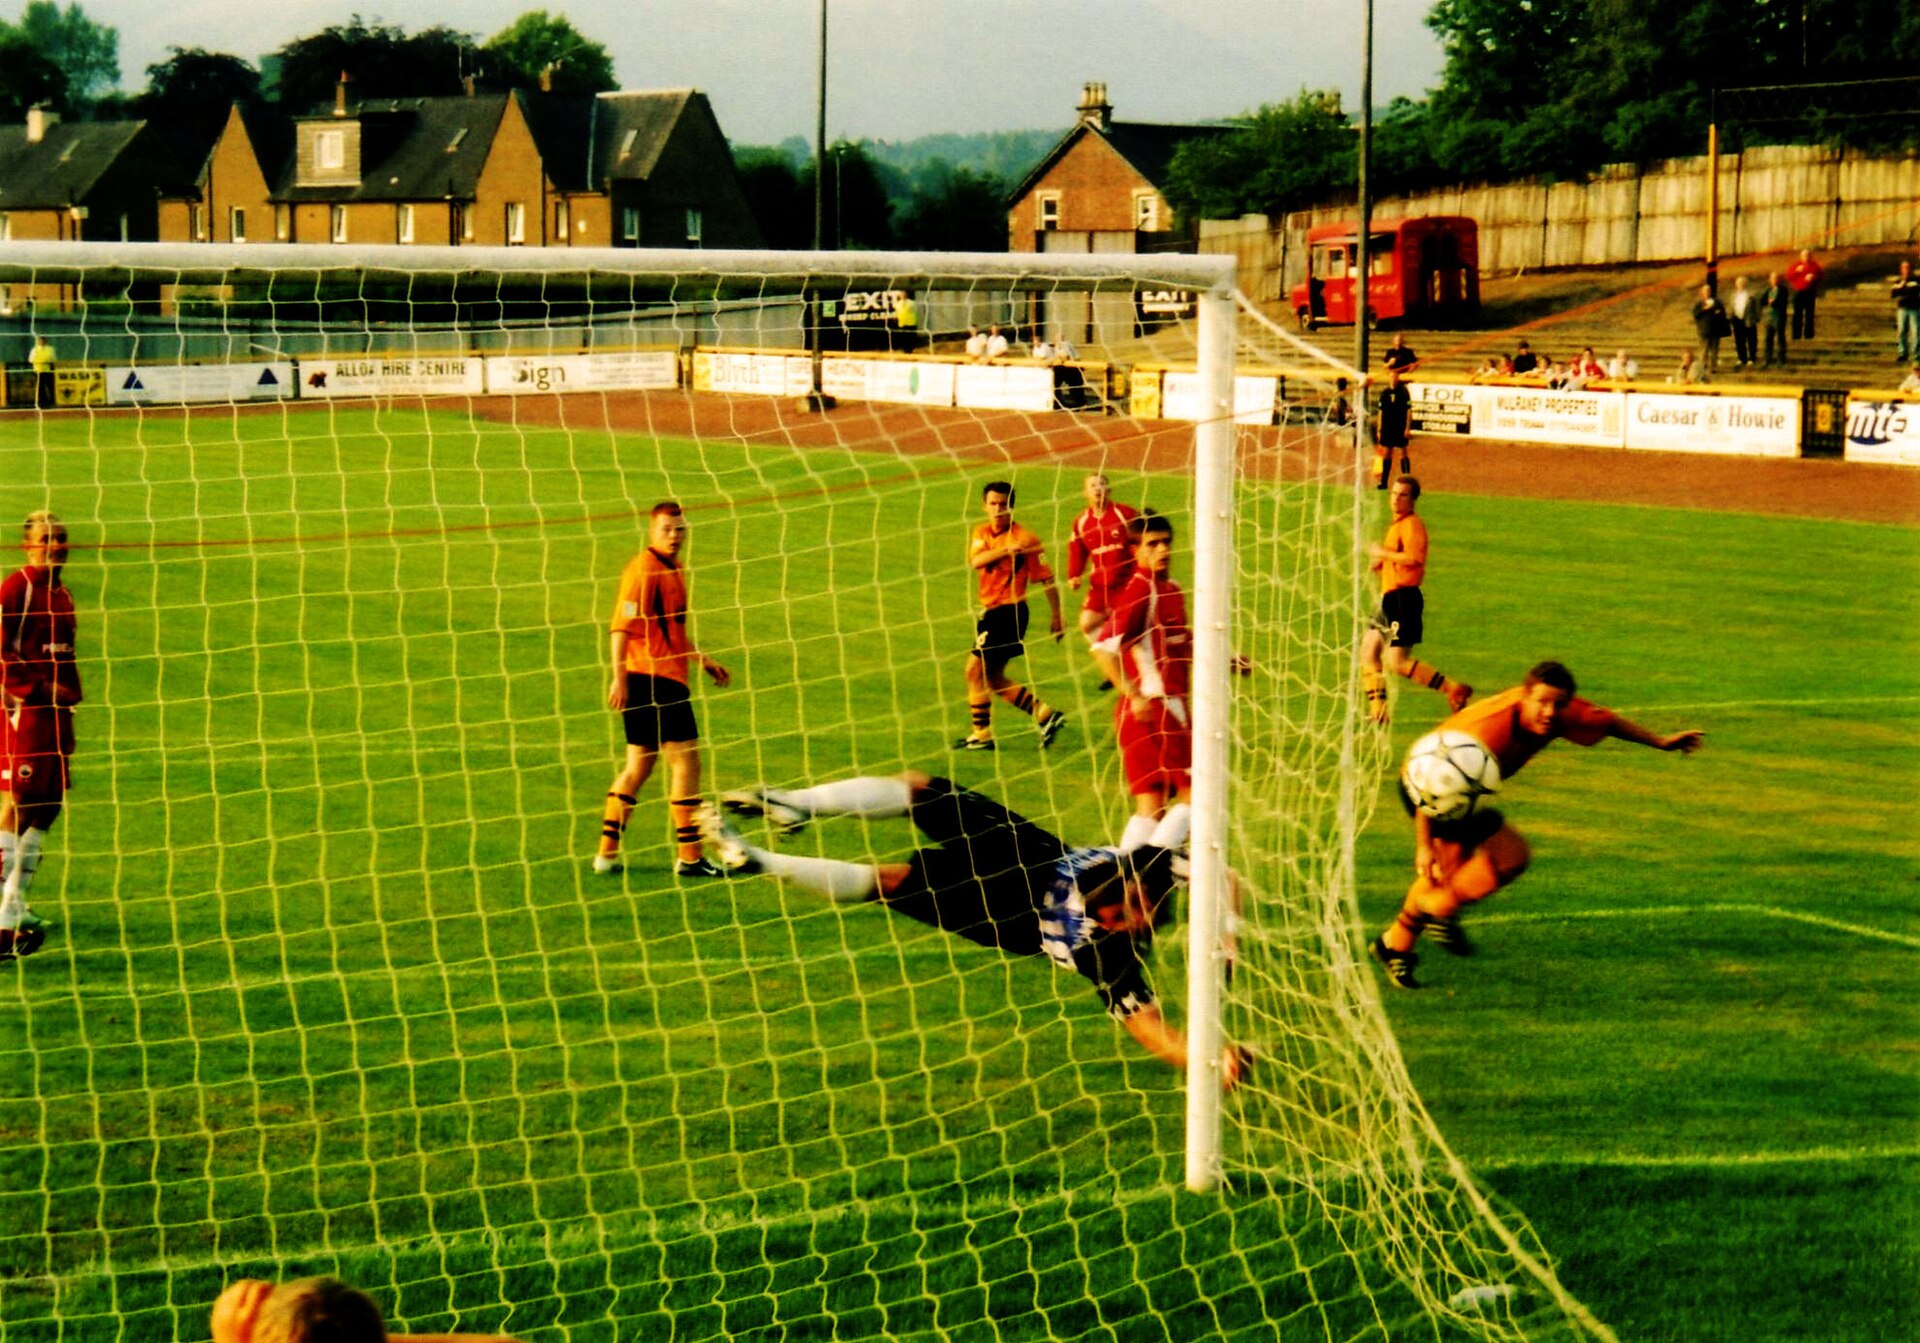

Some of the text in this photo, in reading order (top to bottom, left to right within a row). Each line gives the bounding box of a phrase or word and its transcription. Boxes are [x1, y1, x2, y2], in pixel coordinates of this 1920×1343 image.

[843, 291, 905, 311] EXIT
[382, 361, 411, 376] HIRE
[418, 361, 466, 376] CENTRE
[1423, 388, 1463, 402] FOR
[1546, 398, 1597, 415] PROPERTIES
[1637, 402, 1698, 425] Caesar
[1728, 405, 1785, 430] Howie
